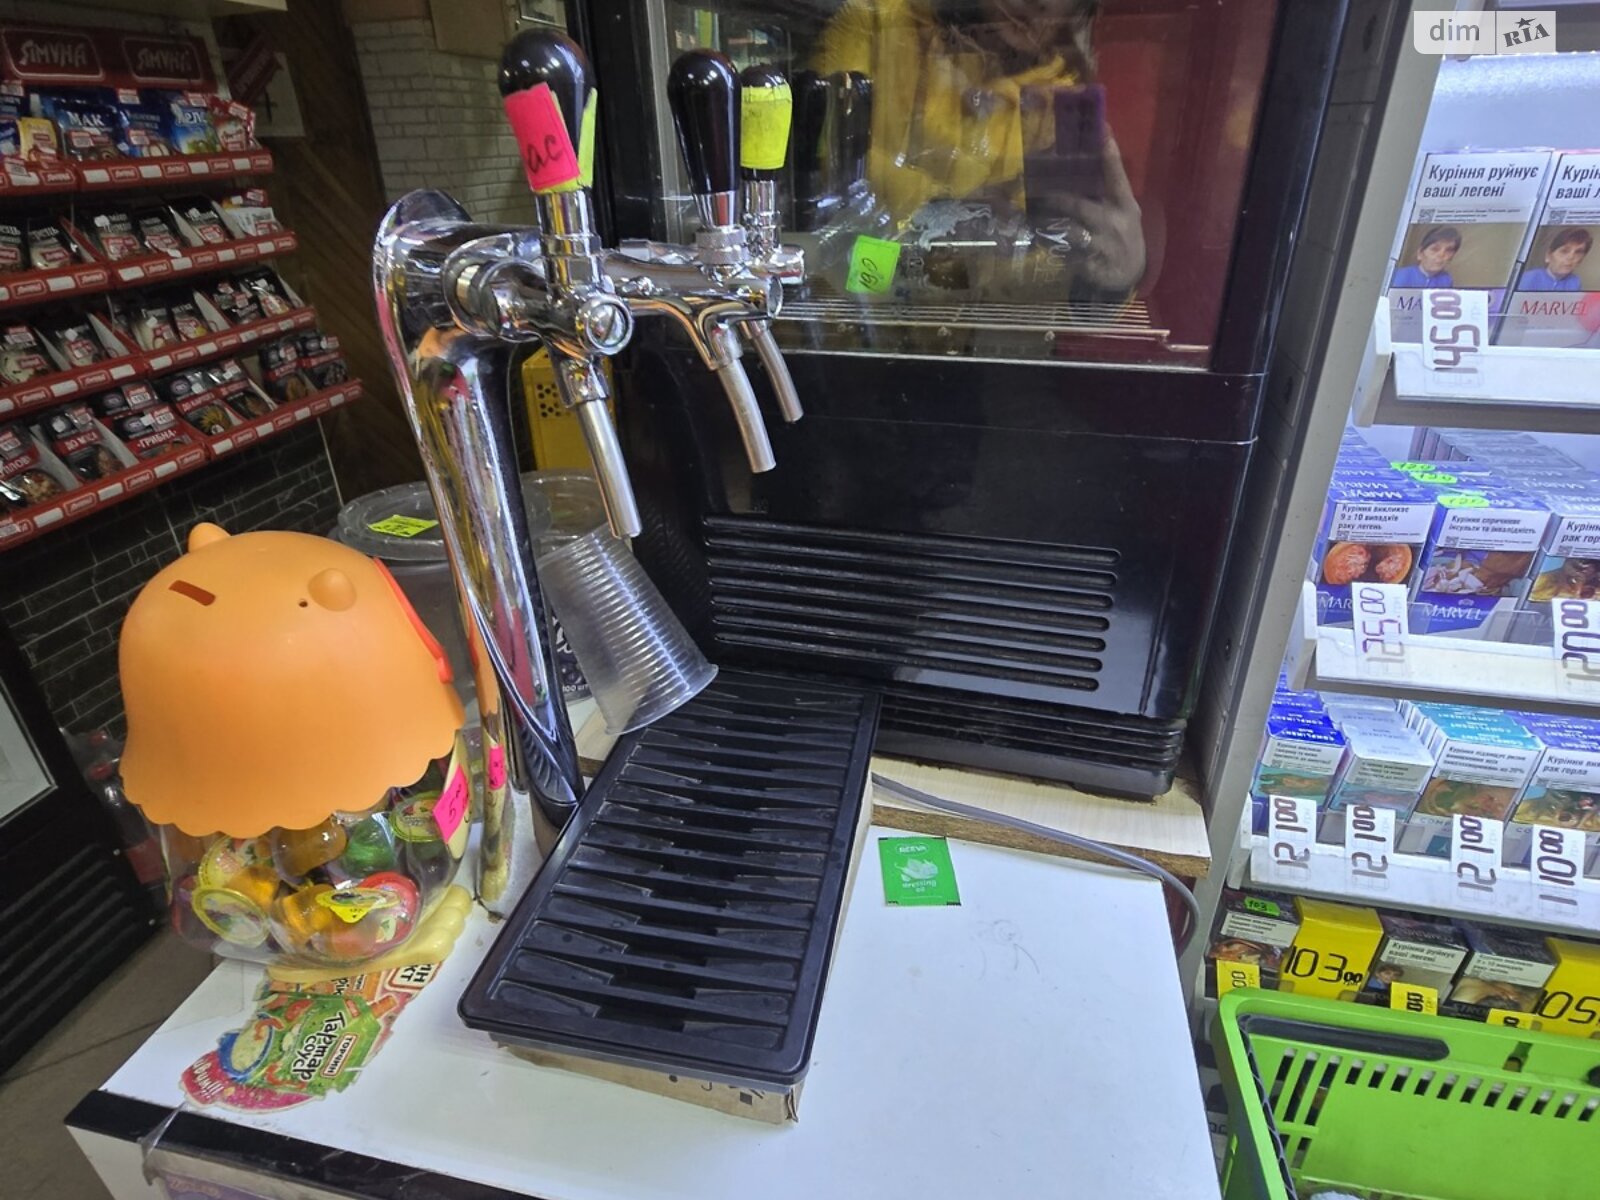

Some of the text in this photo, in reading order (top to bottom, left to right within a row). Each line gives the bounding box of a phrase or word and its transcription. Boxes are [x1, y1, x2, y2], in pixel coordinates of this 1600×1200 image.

[1429, 164, 1539, 182] Куріння руйнує
[1562, 164, 1600, 183] Курін
[1422, 182, 1506, 198] ваші легені
[1556, 183, 1592, 199] ваші
[1520, 301, 1588, 316] MARVEL
[1561, 535, 1581, 543] рак
[1320, 595, 1353, 609] MAR
[1422, 603, 1483, 621] MARVEL
[1547, 755, 1585, 766] Куріння
[1542, 765, 1560, 773] рак
[1392, 942, 1425, 953] Куріння
[299, 1011, 347, 1082] Тартар
[292, 1035, 318, 1076] соус
[327, 1037, 353, 1075] ТОРЧИН
